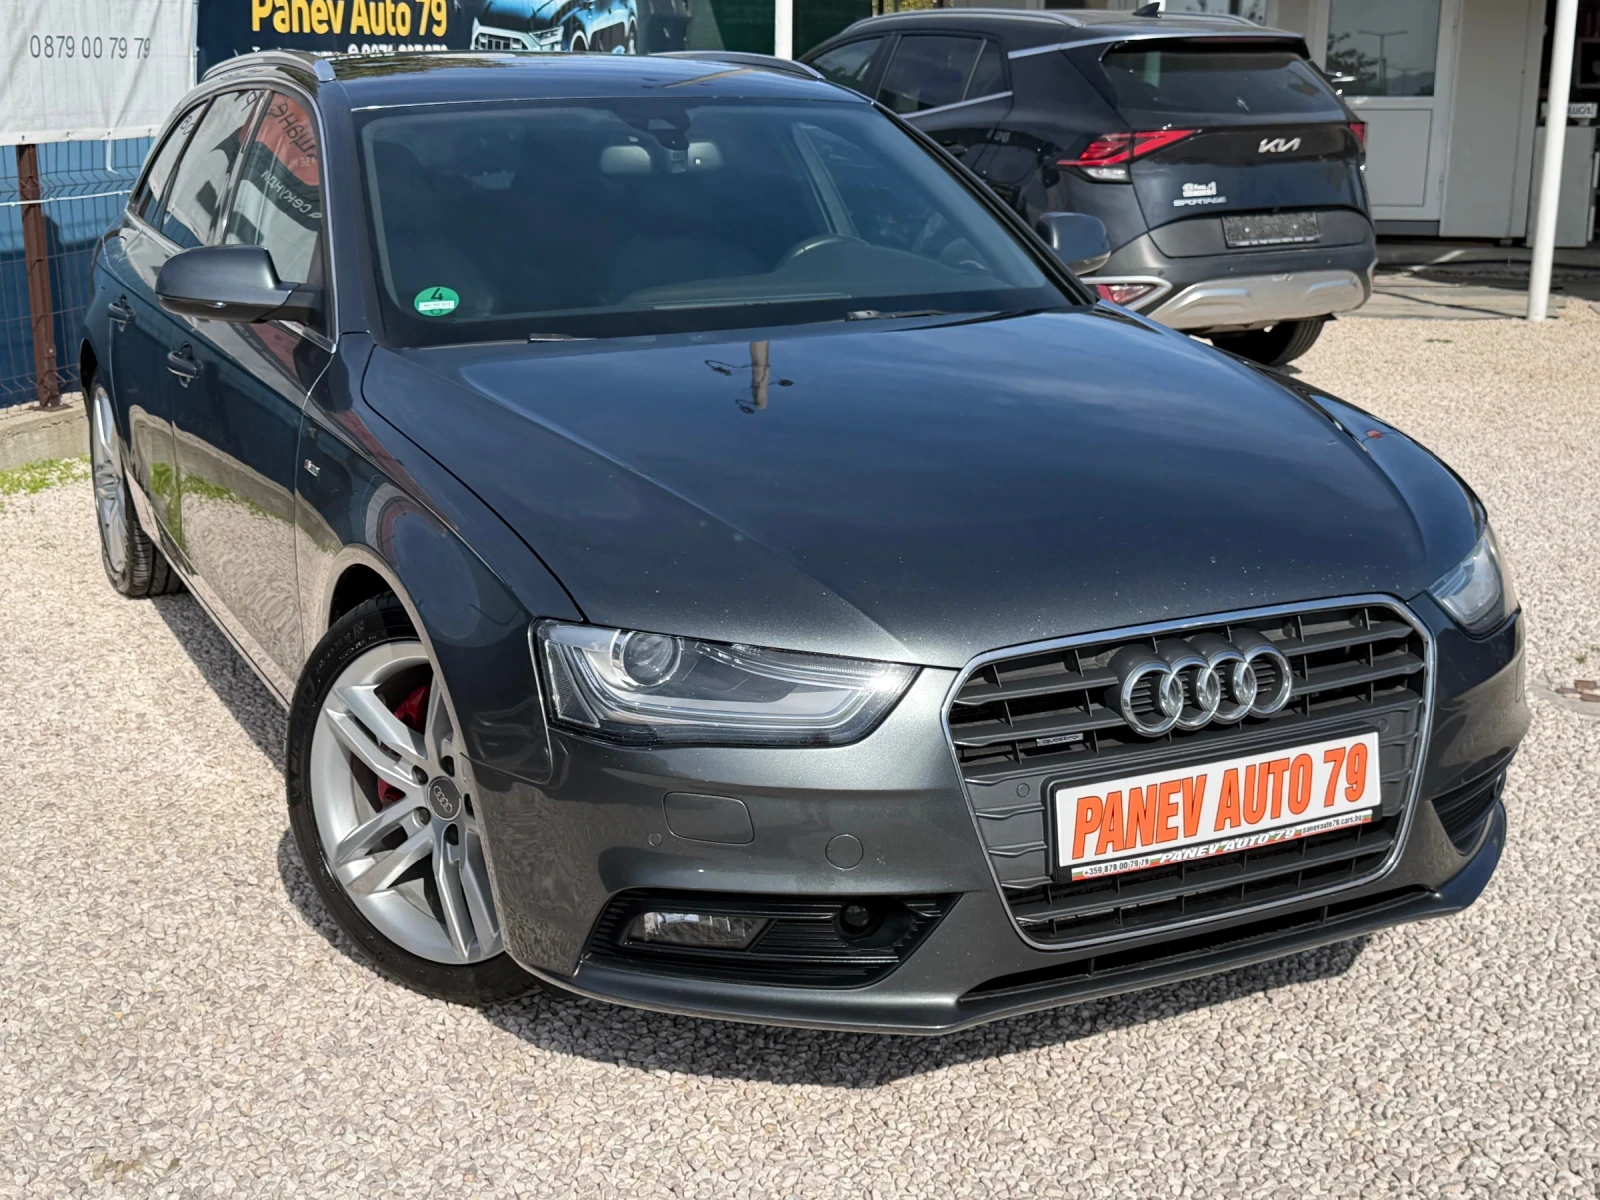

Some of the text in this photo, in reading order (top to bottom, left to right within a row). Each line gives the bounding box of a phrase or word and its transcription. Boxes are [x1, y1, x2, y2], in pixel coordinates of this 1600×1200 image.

[252, 0, 447, 37] Panev Auto 79
[30, 35, 151, 59] 0879 00 79 79
[431, 288, 444, 301] 4
[1072, 743, 1368, 860] PANEV AUTO 79
[1159, 827, 1297, 864] PANEV AUTO 79
